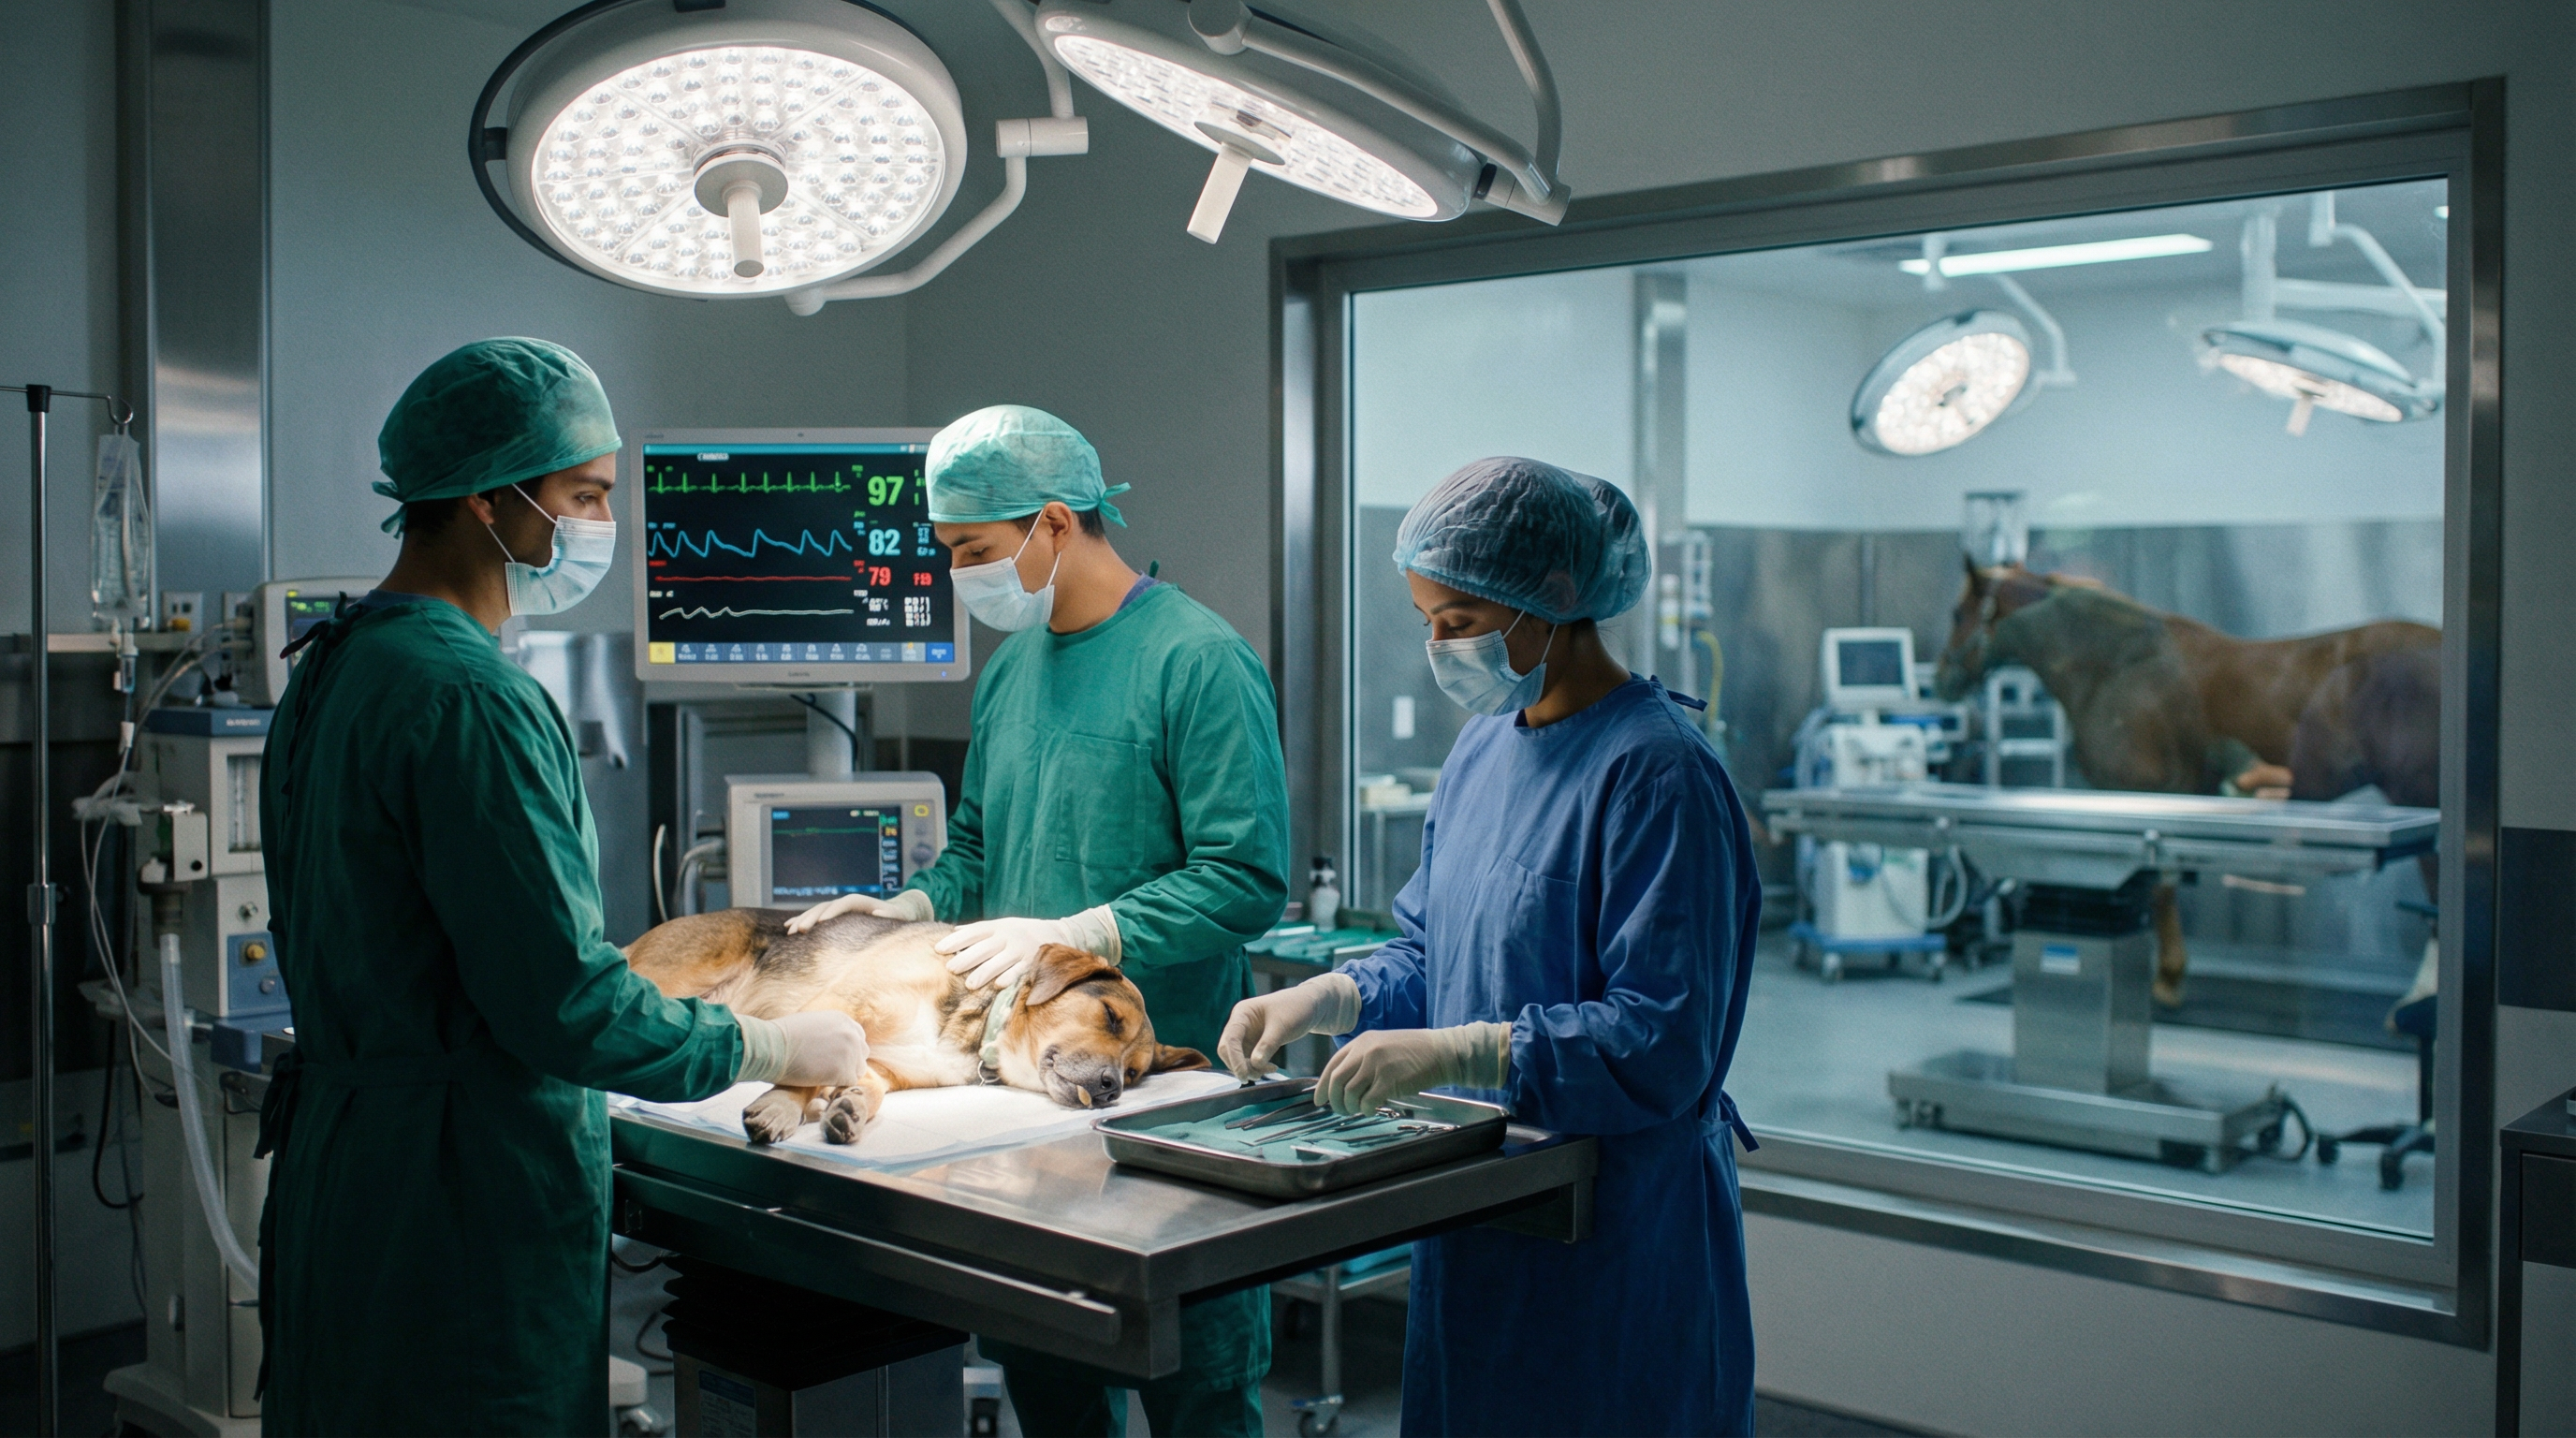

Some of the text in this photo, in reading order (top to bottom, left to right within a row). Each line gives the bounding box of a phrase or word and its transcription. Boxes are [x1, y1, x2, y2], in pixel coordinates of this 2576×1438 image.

[868, 476, 904, 506] 97
[869, 529, 901, 556] 82
[868, 566, 891, 586] 79
